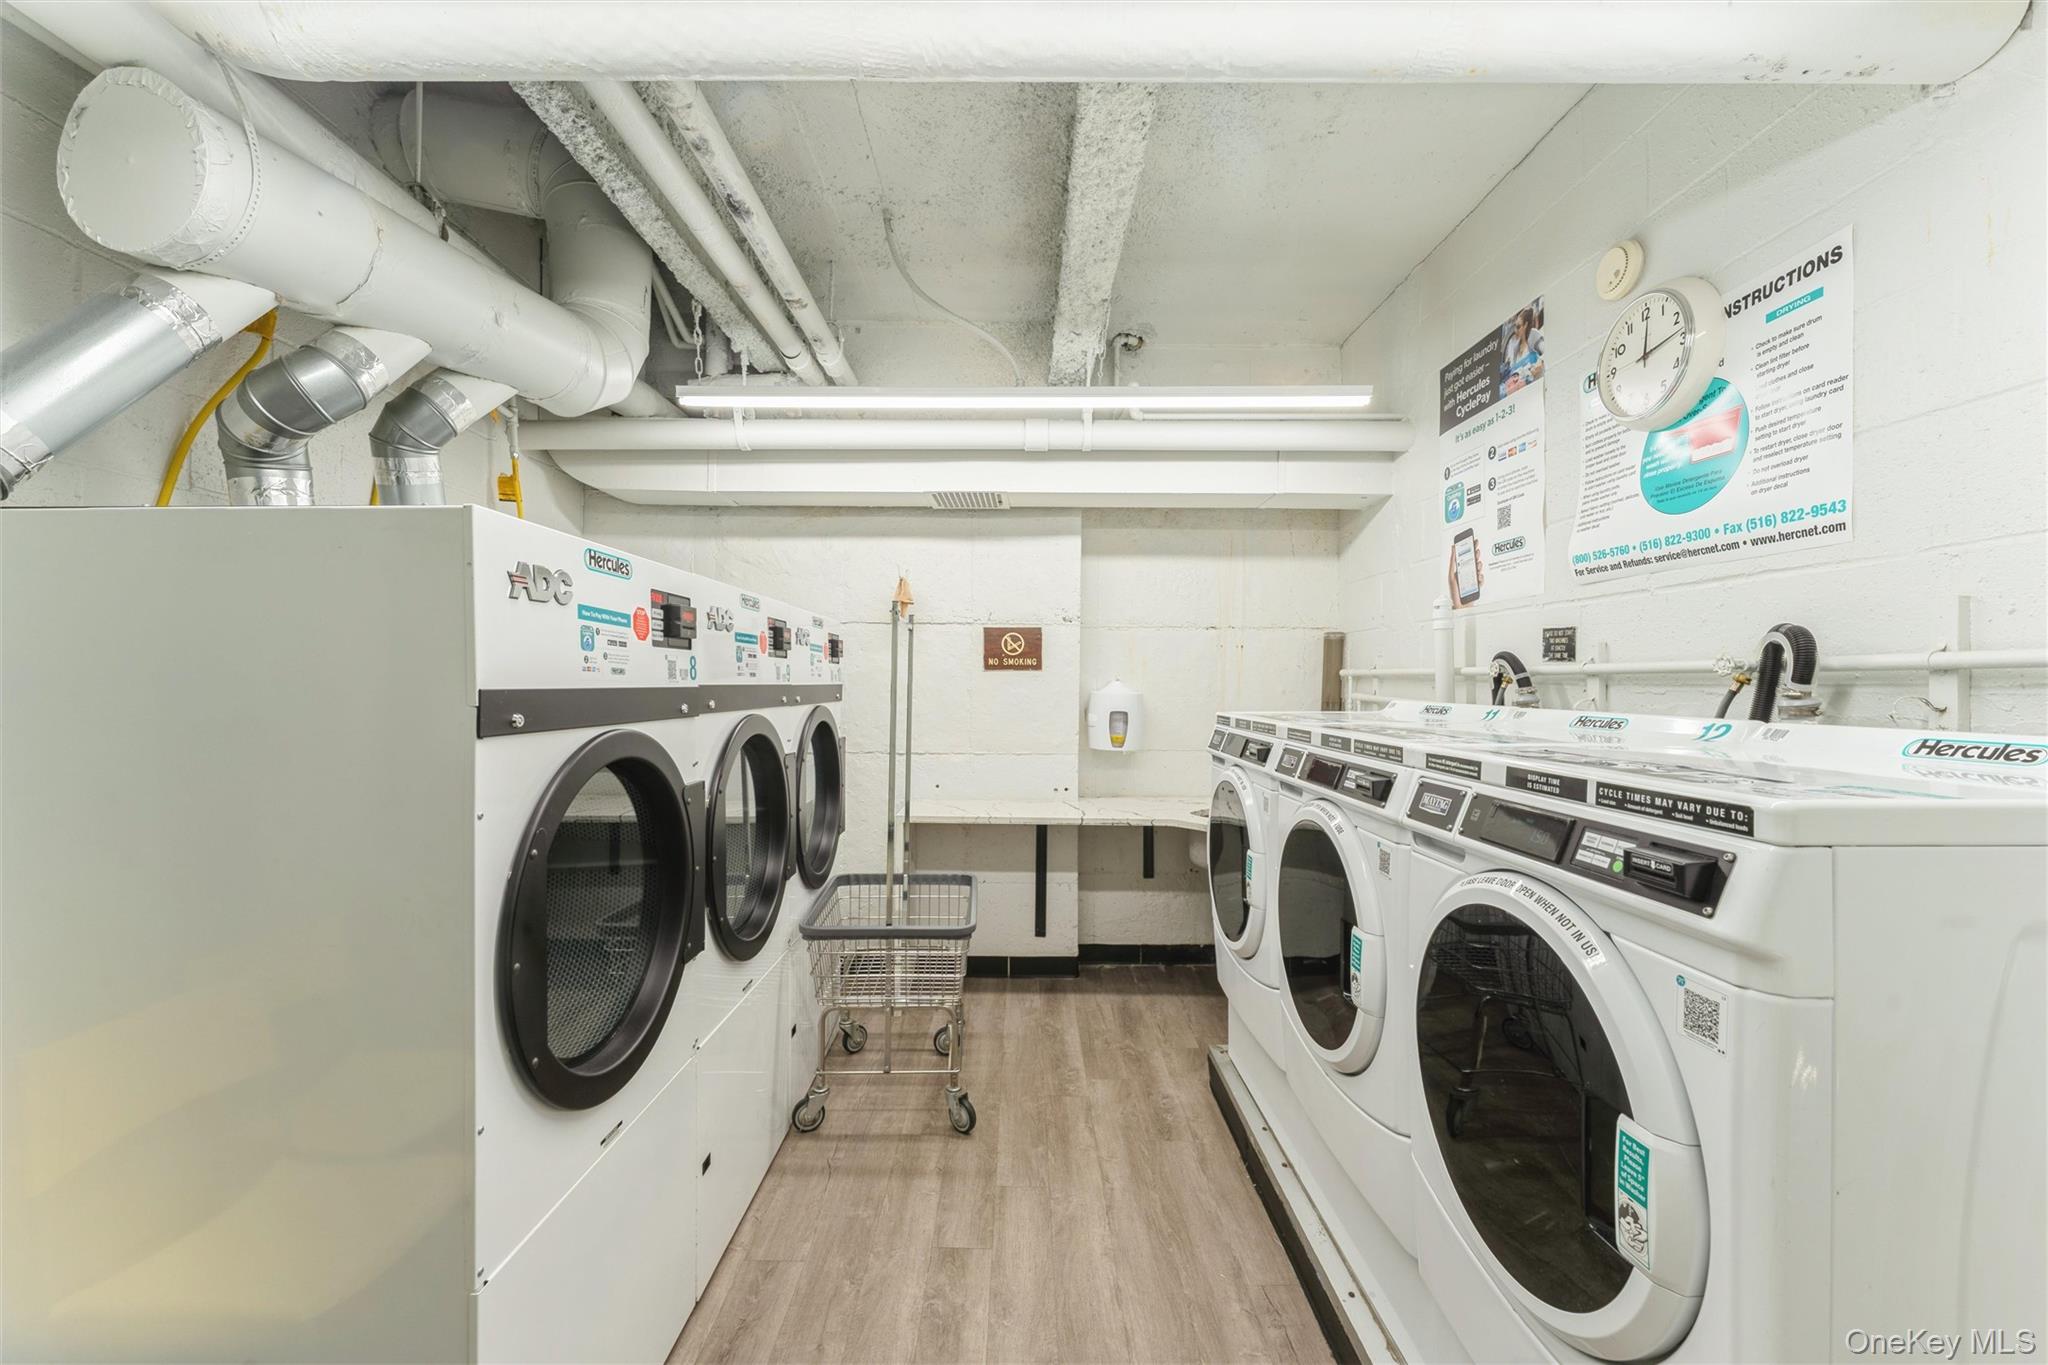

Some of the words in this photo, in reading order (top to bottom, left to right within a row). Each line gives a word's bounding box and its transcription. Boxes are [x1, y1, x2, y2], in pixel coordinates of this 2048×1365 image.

[1724, 245, 1843, 319] NSTRUCTIONS
[1641, 306, 1650, 322] 12
[1775, 294, 1812, 317] DRYING
[1673, 311, 1680, 326] 2
[1627, 323, 1633, 336] 11
[1679, 331, 1685, 345] 3
[1755, 338, 1771, 350] Check
[1778, 328, 1792, 340] make
[1793, 322, 1806, 332] sure
[1806, 315, 1823, 327] drum
[1615, 343, 1626, 358] 10
[1762, 344, 1778, 356] empty
[1778, 338, 1789, 348] and
[1789, 332, 1804, 343] clean
[1444, 363, 1464, 383] Paying
[1463, 356, 1473, 368] for
[1473, 340, 1499, 363] laundry
[1754, 360, 1769, 371] Clean
[1769, 356, 1778, 365] lint
[1778, 351, 1791, 361] filter
[1791, 343, 1810, 355] before
[1610, 367, 1617, 379] 9
[1756, 365, 1776, 379] starting
[1776, 359, 1791, 371] dryer
[1787, 368, 1798, 379] and
[1798, 363, 1814, 374] close
[1444, 382, 1454, 400] just
[1453, 376, 1465, 392] got
[1464, 365, 1485, 386] easier
[1660, 379, 1668, 393] 5
[1802, 386, 1811, 395] on
[1811, 381, 1826, 392] card
[1826, 374, 1849, 386] reader
[1444, 398, 1456, 412] with
[1456, 376, 1491, 404] Hercules
[1455, 390, 1492, 418] CyclePay
[1761, 409, 1773, 419] start
[1804, 389, 1828, 403] laundry
[1828, 384, 1845, 396] card
[1472, 421, 1486, 436] easy
[1495, 403, 1516, 423] 1-2-3!
[1755, 424, 1767, 434] Push
[1768, 418, 1787, 430] desired
[1755, 431, 1773, 442] setting
[1779, 424, 1792, 434] start
[1792, 419, 1807, 431] dryer
[1760, 441, 1778, 453] restart
[1792, 432, 1809, 443] close
[1826, 421, 1843, 432] door
[1763, 448, 1784, 461] reselect
[1784, 438, 1818, 454] temperature
[1760, 464, 1770, 472] not
[1770, 458, 1793, 471] overload
[1793, 453, 1809, 465] dryer
[1777, 467, 1811, 480] instructions
[1758, 484, 1773, 495] dryer
[1773, 480, 1789, 492] decal
[1572, 552, 1592, 566] (800)
[1592, 544, 1631, 561] 526-5760
[1639, 538, 1663, 553] (516)
[1664, 527, 1712, 547] 822-9300
[1723, 522, 1743, 536] Fax
[1745, 513, 1778, 533] (516)
[1780, 498, 1848, 524] 822-9543
[1493, 537, 1524, 555] Hercules
[1574, 568, 1585, 577] For
[1585, 562, 1609, 576] Service
[1609, 560, 1623, 572] and
[1623, 555, 1654, 570] Refunds:
[1654, 540, 1741, 564] service@hercnet.com
[1750, 521, 1847, 547] www.hercnet.com
[588, 549, 631, 577] Hercules
[507, 560, 574, 607] ADC
[689, 655, 697, 681] 8
[988, 657, 999, 666] NO
[1003, 657, 1037, 666] SMOKING
[1481, 708, 1501, 721] 11
[1573, 715, 1625, 731] Hercules
[1692, 722, 1734, 742] 12
[1912, 738, 2043, 764] Hercules
[1526, 781, 1533, 789] IS
[1533, 783, 1560, 794] ESTIMATED
[1527, 773, 1547, 784] DISPLAY
[1547, 777, 1560, 787] TIME
[1423, 794, 1449, 811] MAYTAG
[1598, 787, 1623, 799] CYCLE
[1625, 791, 1651, 805] TIMES
[1654, 797, 1673, 808] MAY
[1676, 801, 1702, 814] VARY
[1706, 806, 1726, 818] DUE
[1730, 810, 1749, 822] TO:
[1626, 803, 1642, 811] Amount
[1709, 818, 1735, 830] Unbalanced
[1735, 823, 1749, 832] loads
[1631, 857, 1651, 867] INSERT
[1655, 863, 1672, 873] CARD
[1515, 883, 1535, 900] OPEN
[1533, 894, 1560, 917] WHEN
[1555, 912, 1577, 932] NOT
[1570, 929, 1586, 943] IN
[1622, 1136, 1633, 1147] For
[1632, 1142, 1646, 1157] Best
[1622, 1144, 1645, 1166] Results,
[1620, 1161, 1637, 1178] Leave
[1623, 1154, 1643, 1173] Please
[1625, 1181, 1646, 1202] Washer
[1627, 1174, 1645, 1192] Space
